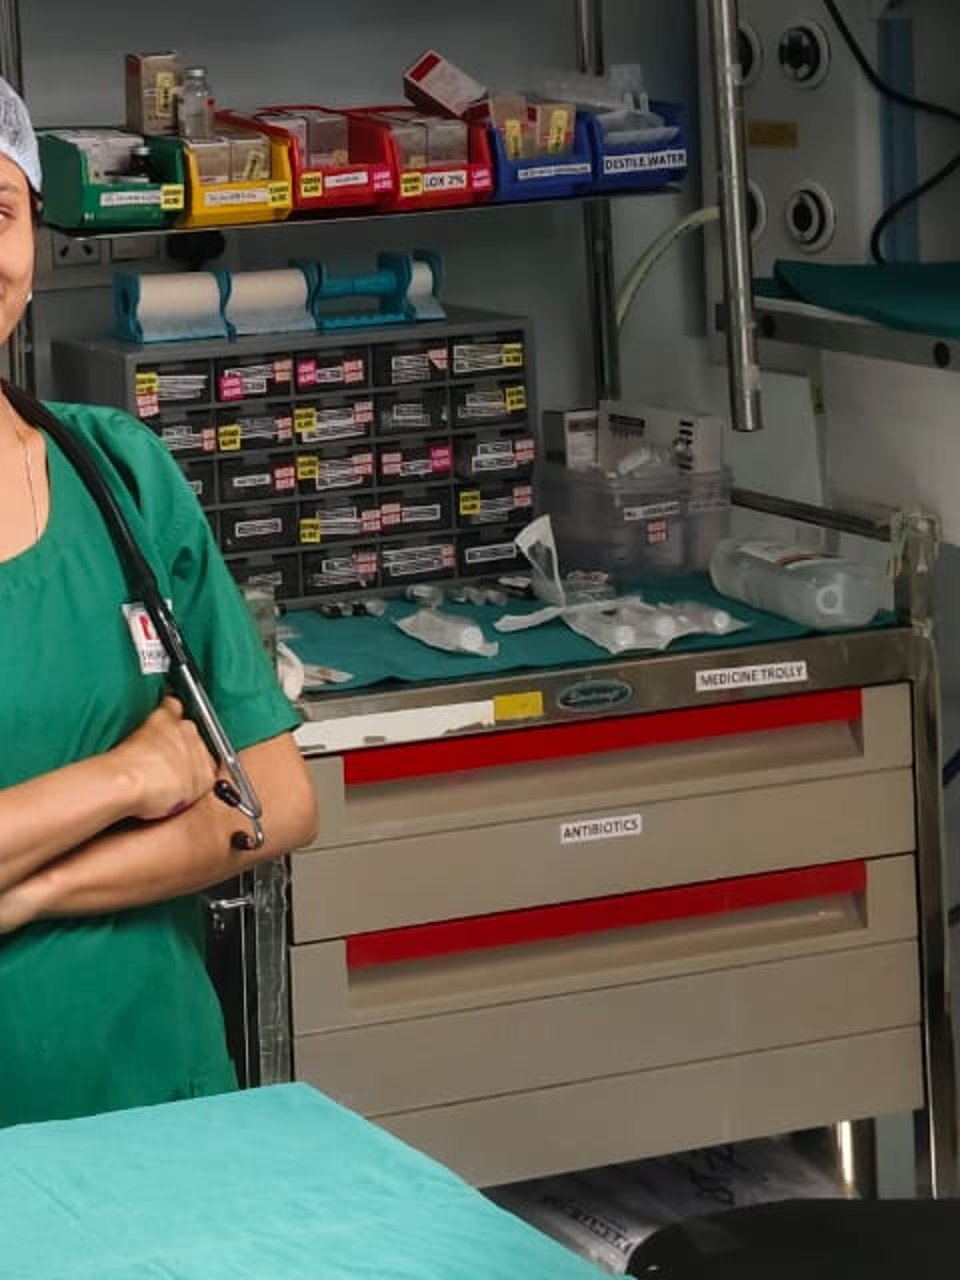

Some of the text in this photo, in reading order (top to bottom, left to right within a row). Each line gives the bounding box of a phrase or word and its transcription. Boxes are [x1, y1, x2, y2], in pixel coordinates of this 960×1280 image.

[648, 153, 684, 166] WATER
[700, 664, 803, 685] MEDICINE TROLLY
[564, 818, 639, 838] ANTIBIOTICS
